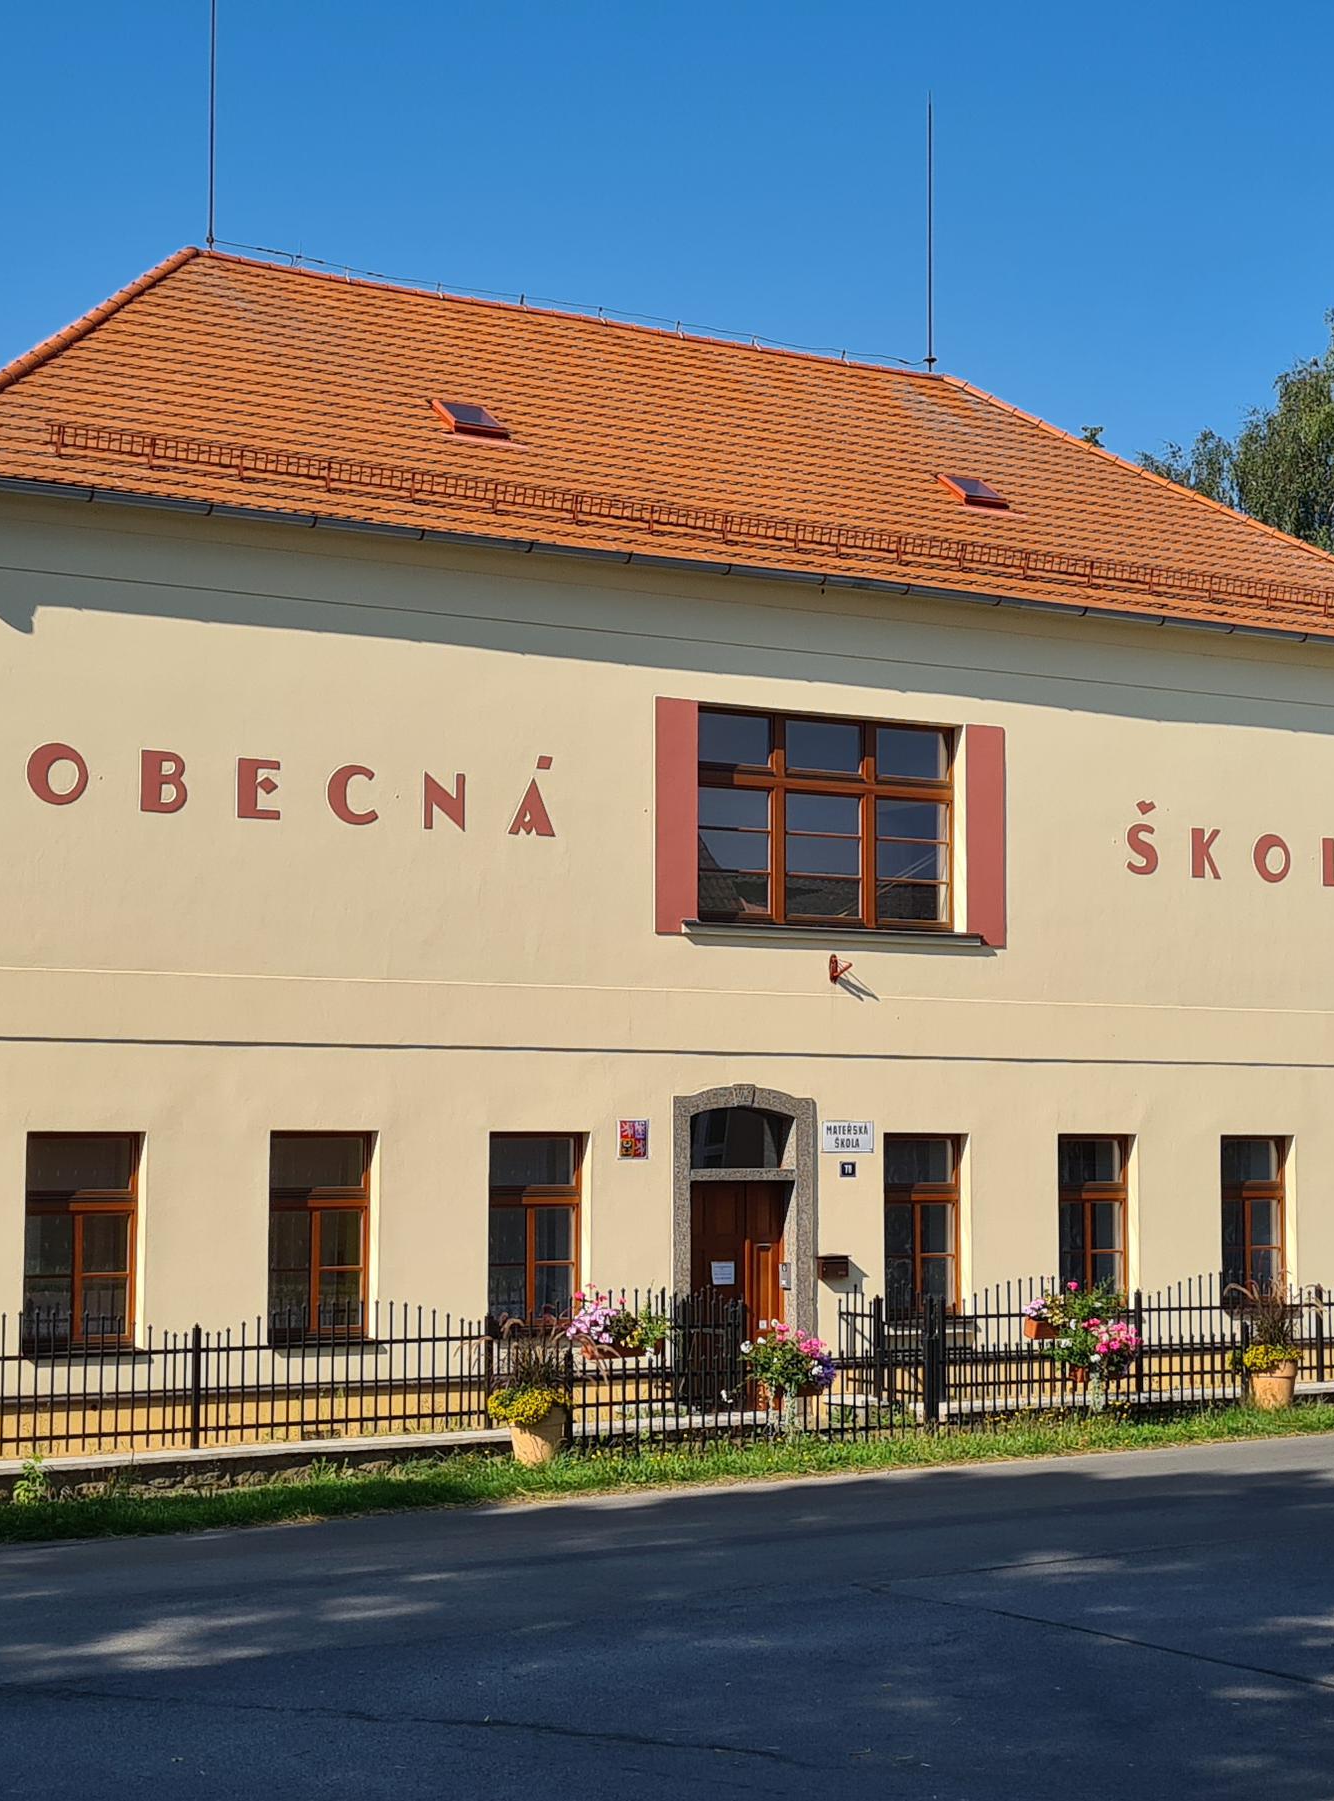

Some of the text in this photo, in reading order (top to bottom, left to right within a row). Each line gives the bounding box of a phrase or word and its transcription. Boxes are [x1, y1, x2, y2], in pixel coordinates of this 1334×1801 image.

[26, 742, 556, 837] OBECNÁ
[826, 1122, 868, 1135] MATEŘSKÁ
[834, 1136, 860, 1149] ŠKOLA
